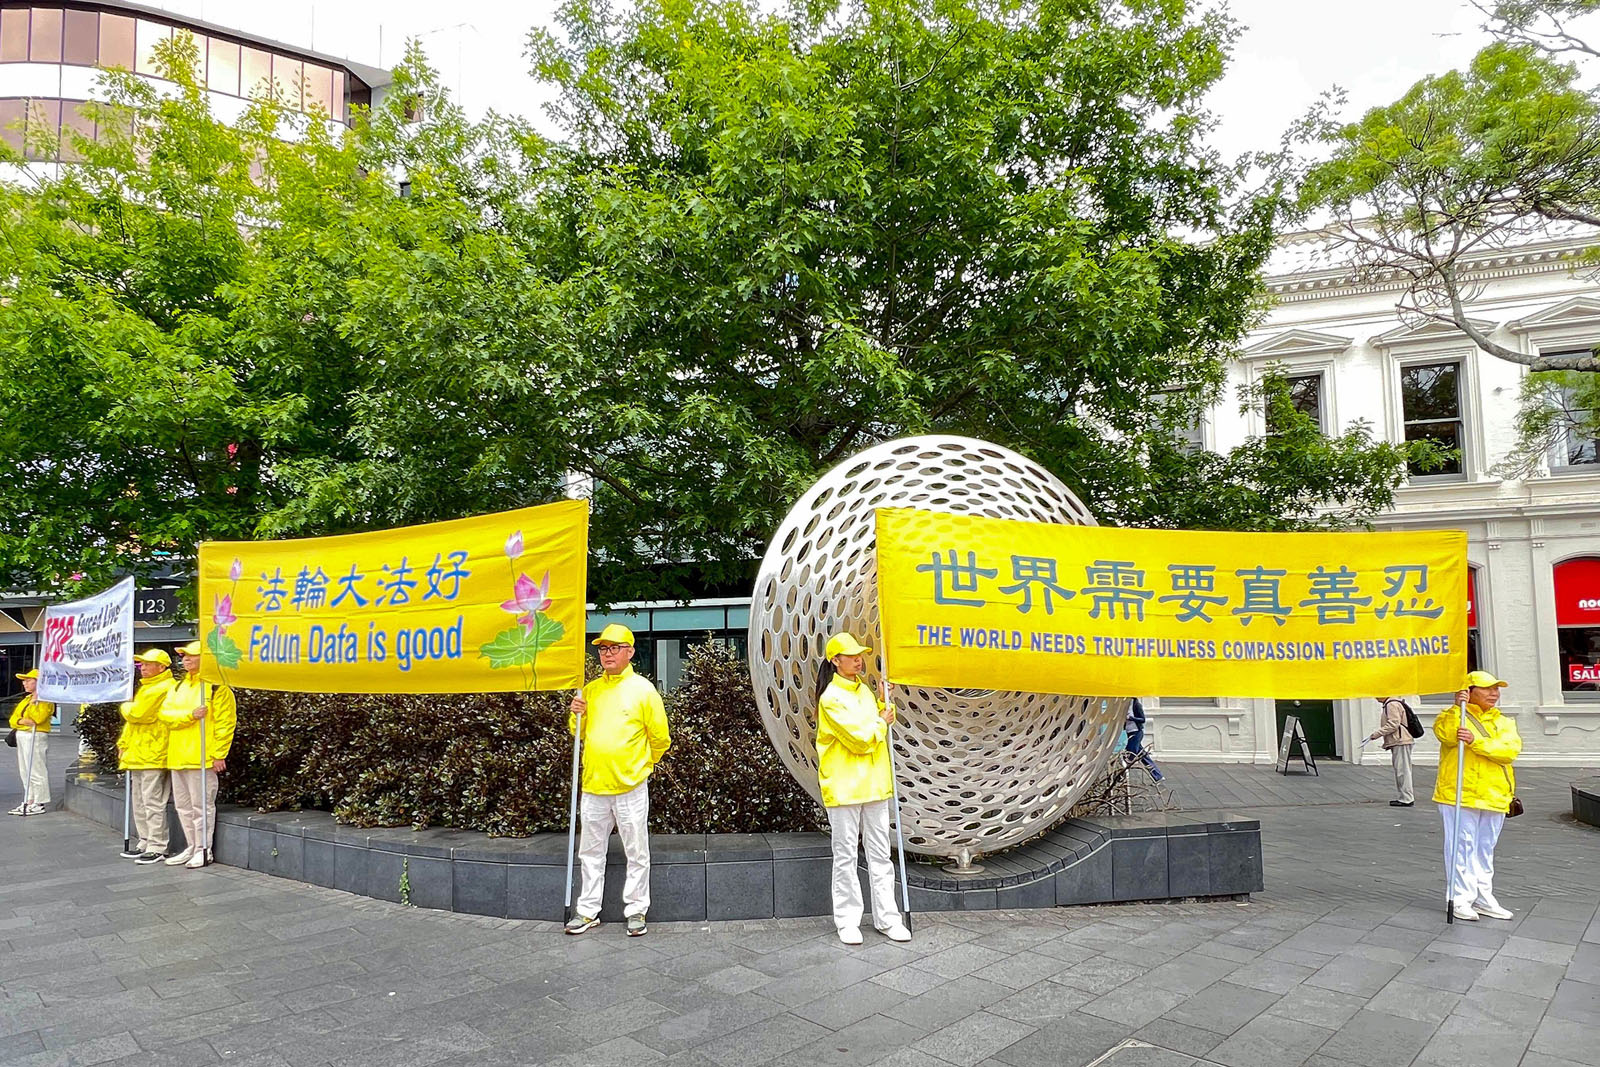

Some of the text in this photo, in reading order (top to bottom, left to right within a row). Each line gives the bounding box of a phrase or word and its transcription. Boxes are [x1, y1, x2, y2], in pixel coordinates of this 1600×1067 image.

[255, 551, 472, 612] 法輪大法好
[916, 549, 1445, 626] 世界需要真善忍
[77, 607, 104, 635] Forced
[139, 598, 166, 614] 123
[249, 615, 463, 672] Falun Dafa is good
[916, 624, 1449, 661] THE WORLD NEEDS TRUTHFULNESS COMPASSION FORBEARANCE
[1572, 669, 1600, 680] SAL
